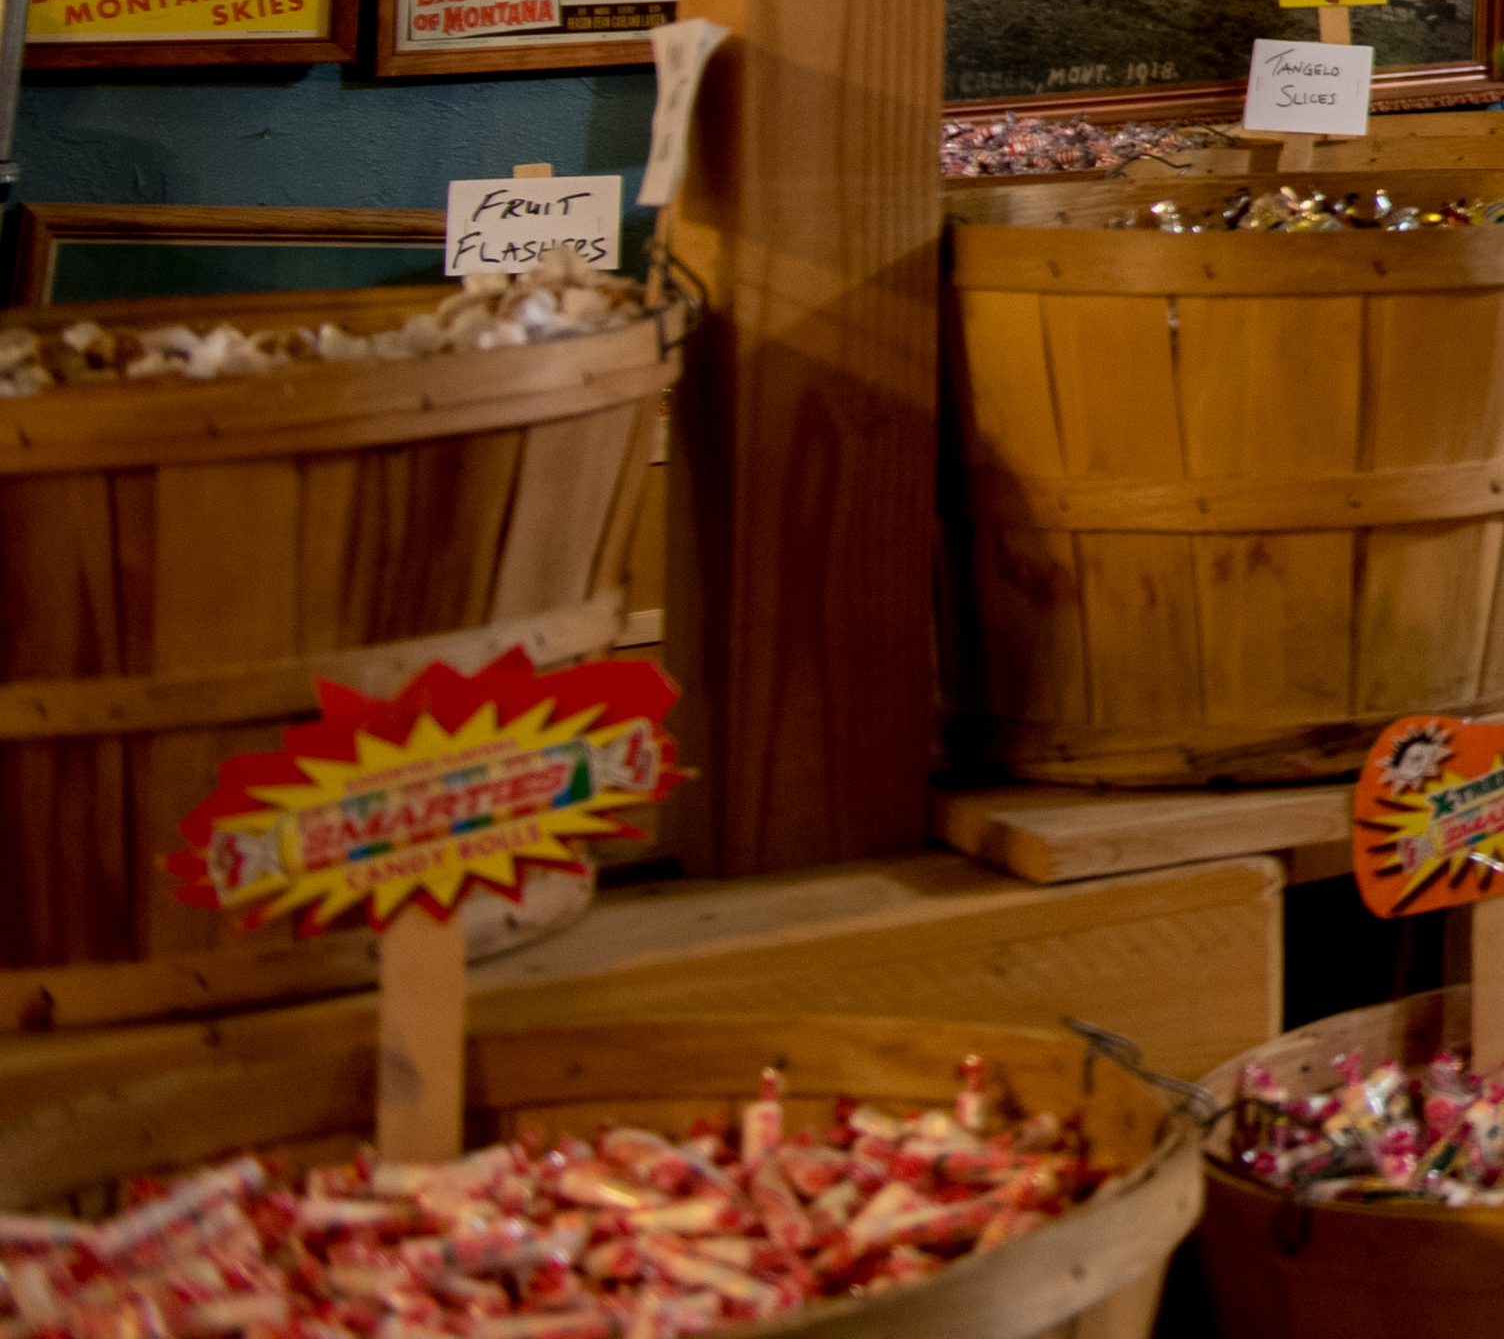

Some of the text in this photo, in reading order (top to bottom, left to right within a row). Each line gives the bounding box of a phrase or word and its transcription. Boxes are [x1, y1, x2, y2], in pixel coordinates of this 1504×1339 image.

[414, 10, 438, 33] OF
[443, 0, 555, 31] MONTANA
[473, 190, 590, 222] FRUIT
